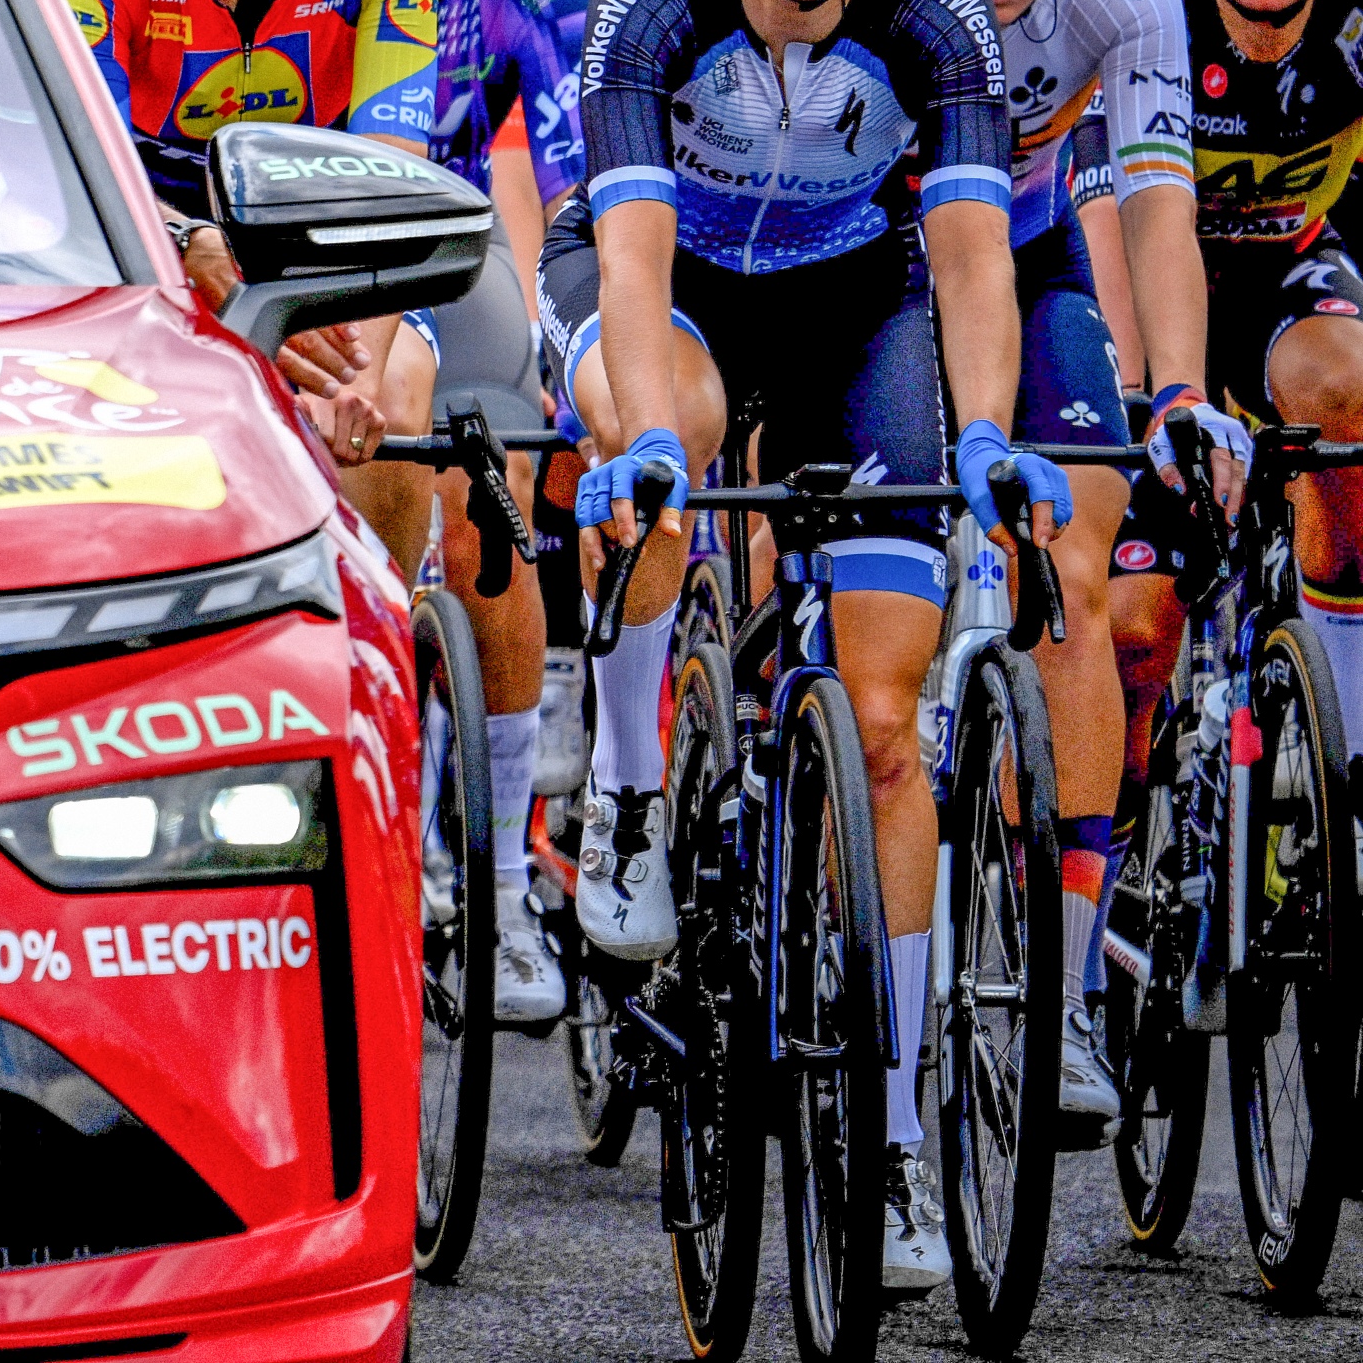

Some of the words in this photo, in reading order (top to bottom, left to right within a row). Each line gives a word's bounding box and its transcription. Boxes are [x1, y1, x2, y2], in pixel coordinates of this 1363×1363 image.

[702, 115, 725, 133] UCI
[693, 131, 749, 156] PROTEAM
[82, 915, 313, 979] ELECTRIC
